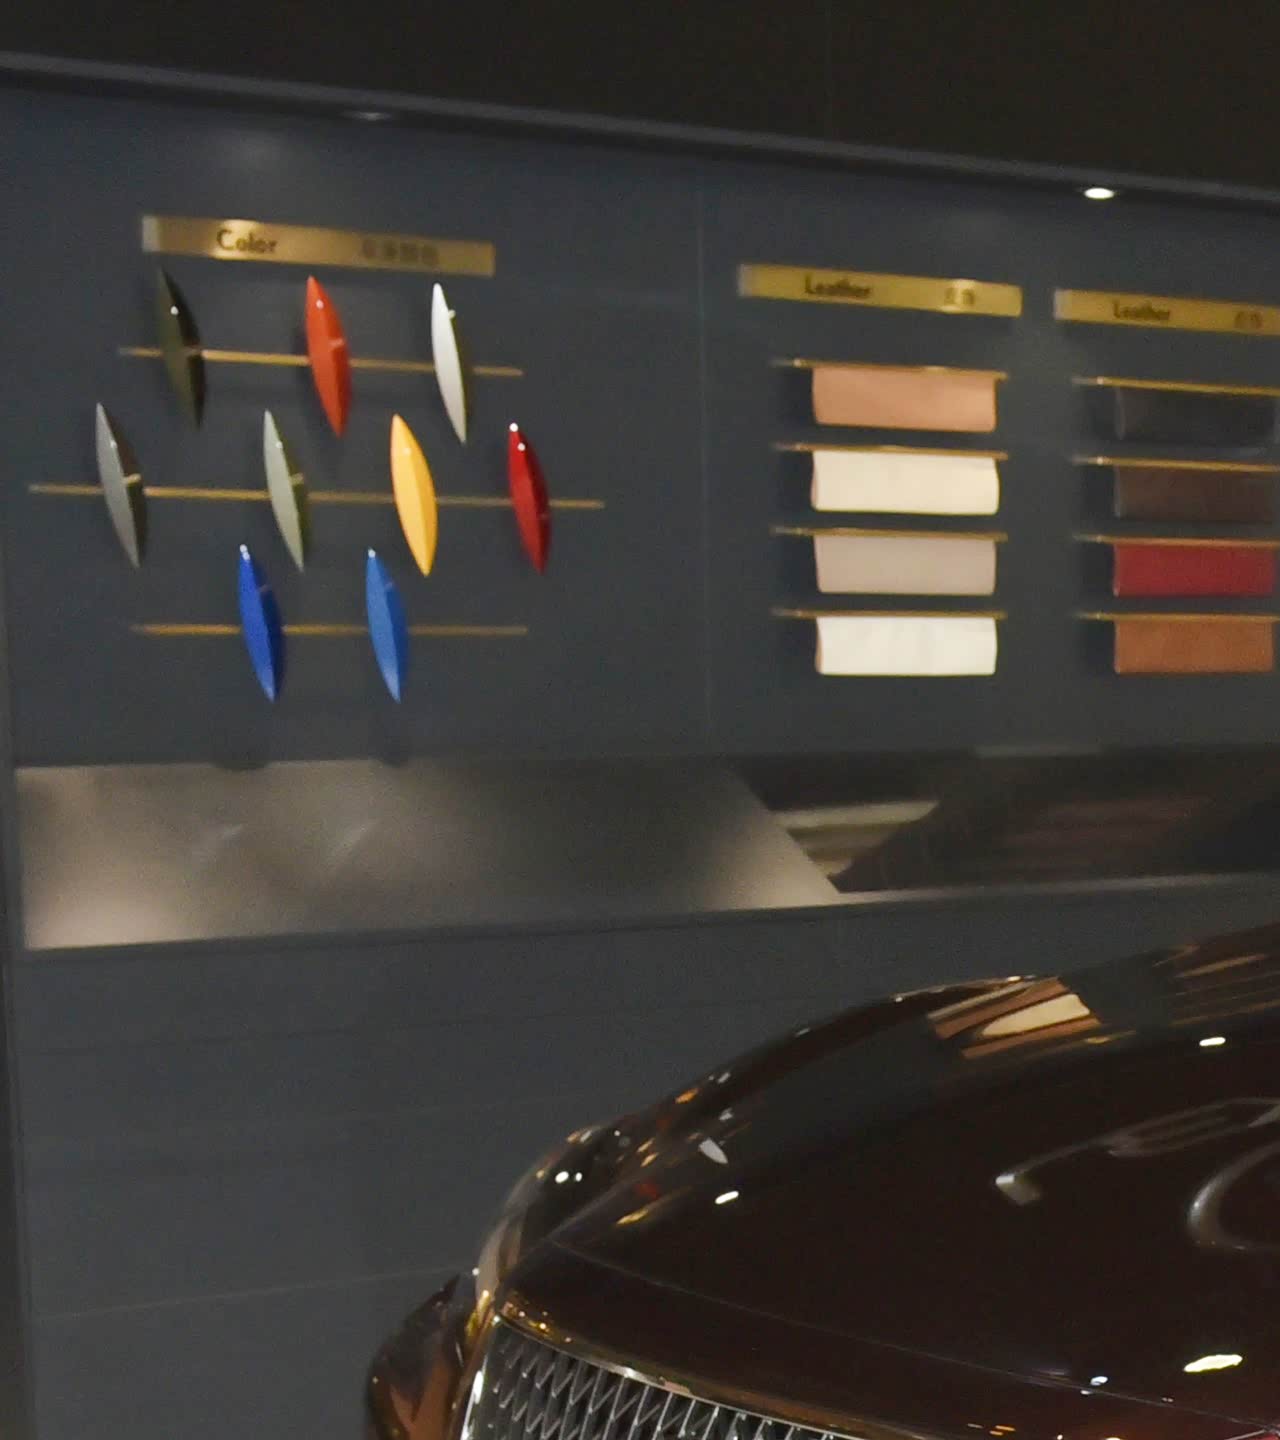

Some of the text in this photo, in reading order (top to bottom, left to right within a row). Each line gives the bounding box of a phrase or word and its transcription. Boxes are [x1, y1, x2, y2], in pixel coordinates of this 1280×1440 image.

[216, 228, 278, 254] Color
[804, 273, 872, 299] Leather
[1113, 301, 1171, 322] Leather
